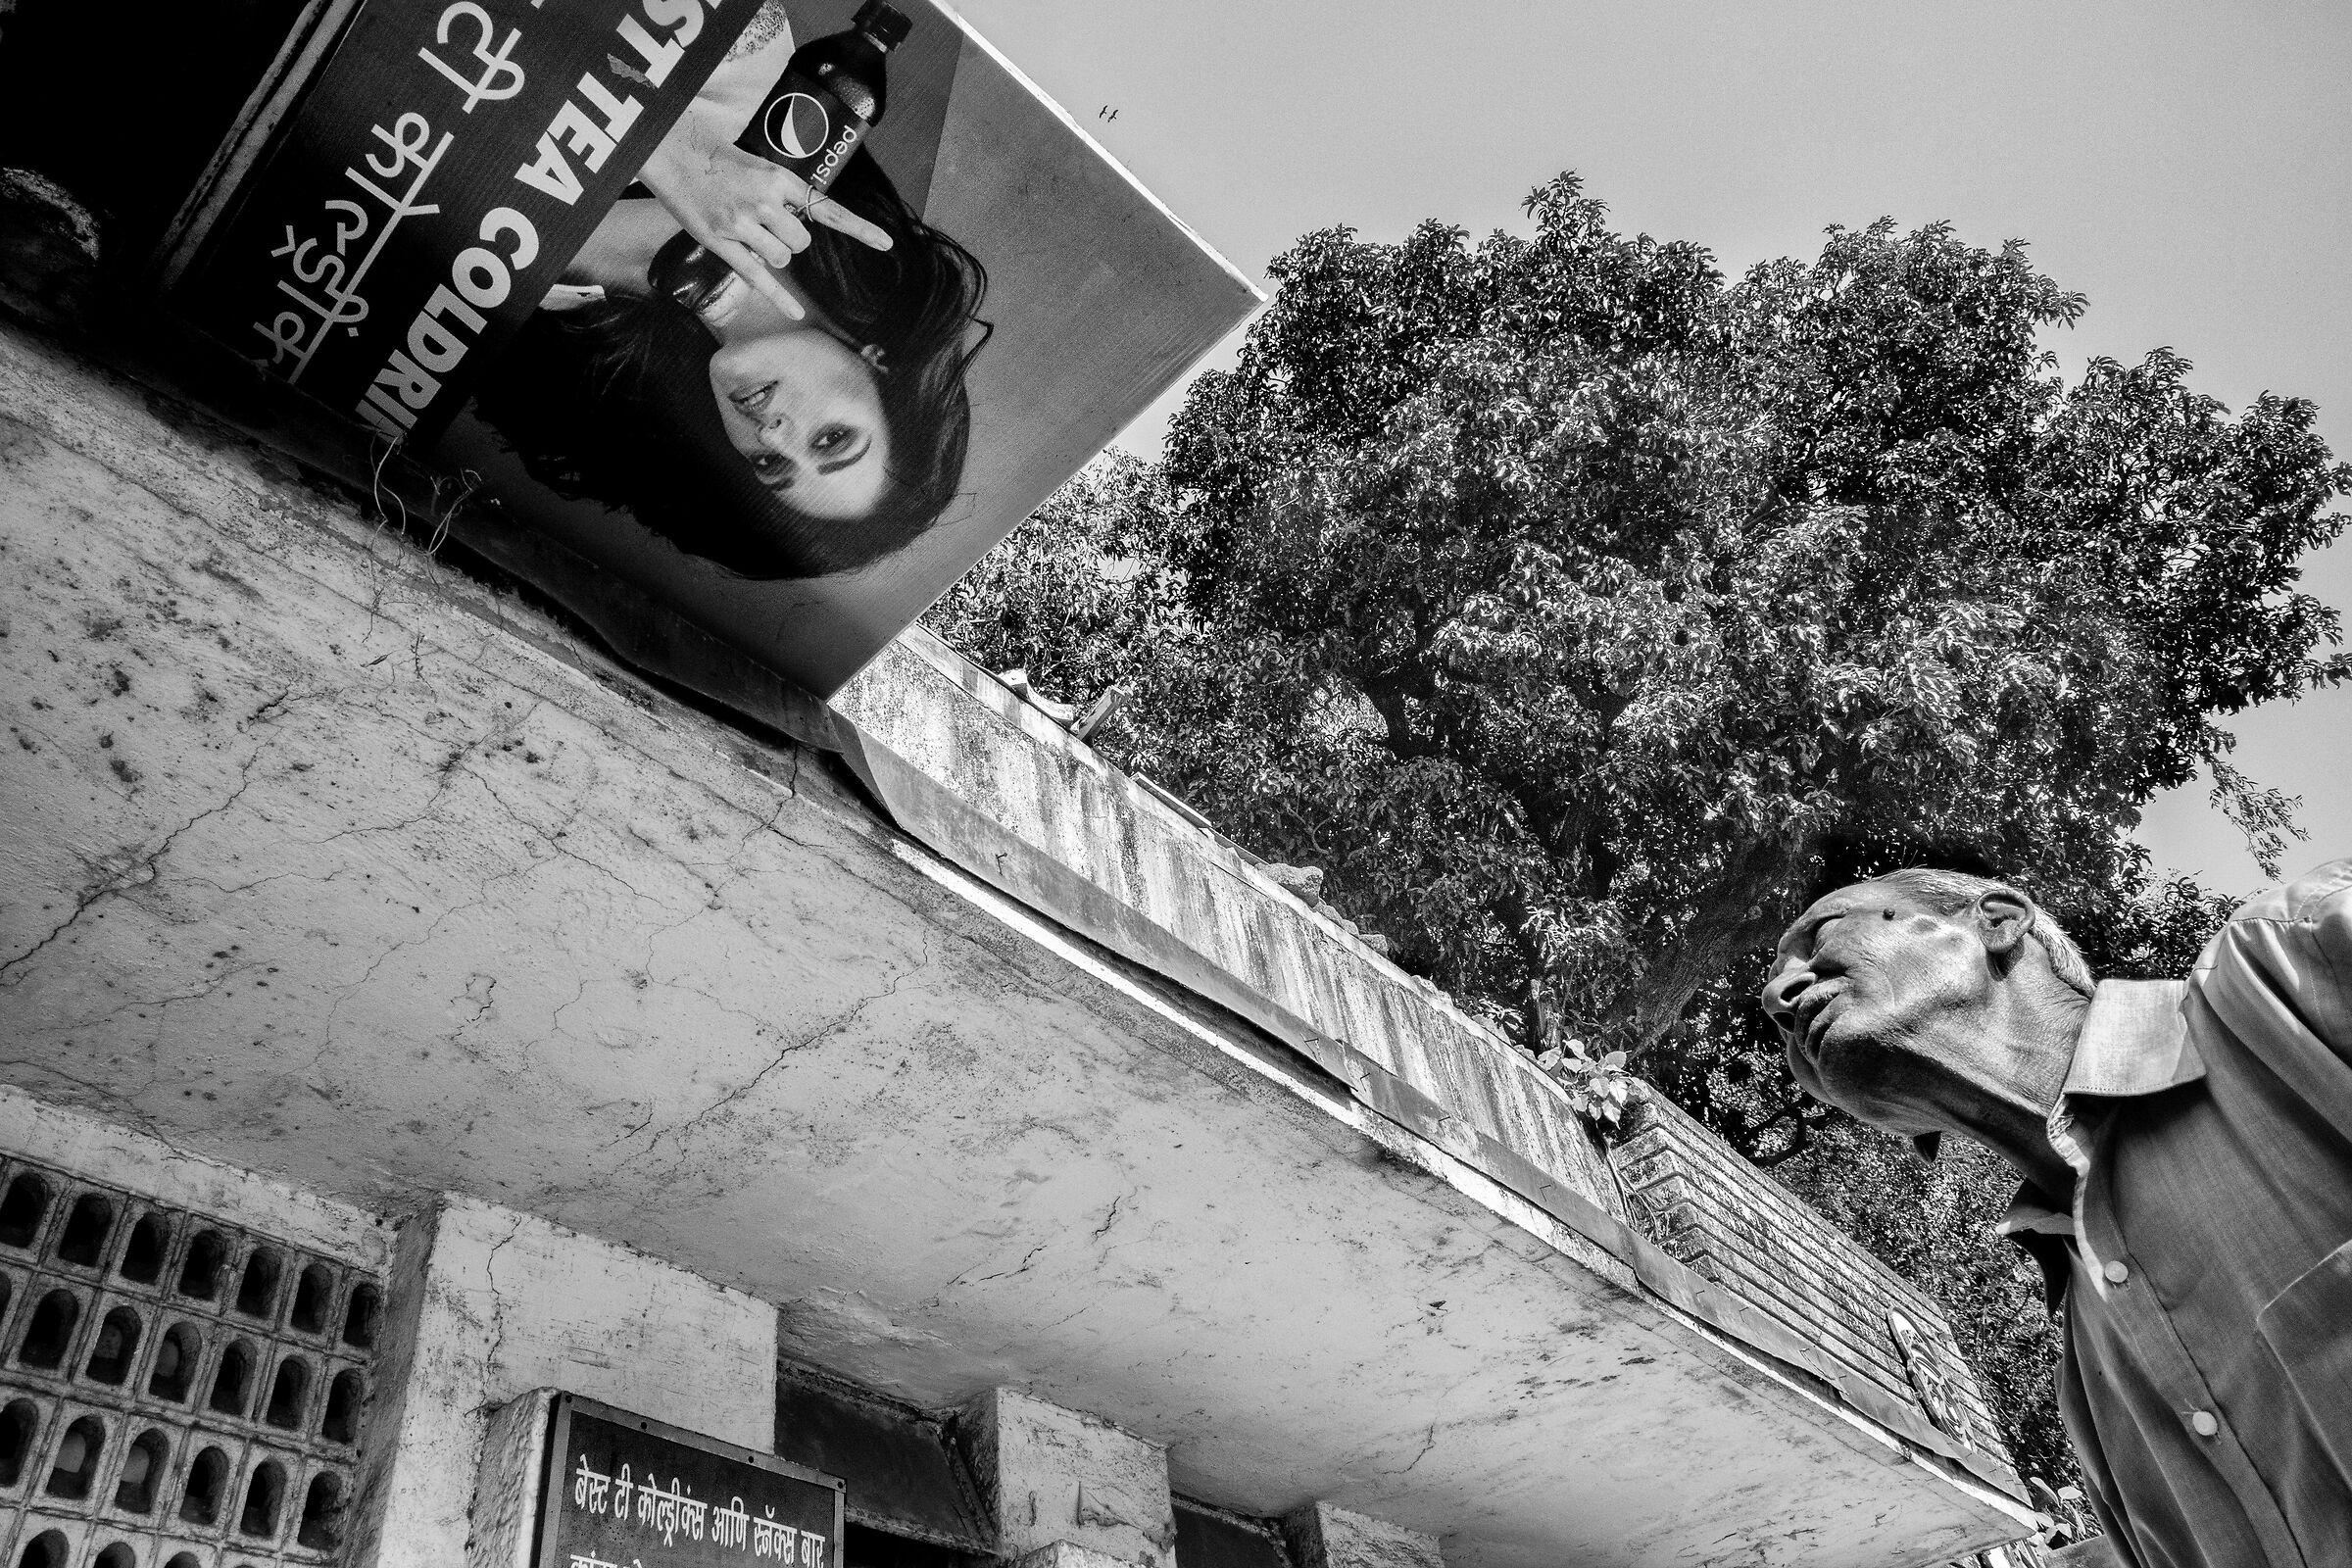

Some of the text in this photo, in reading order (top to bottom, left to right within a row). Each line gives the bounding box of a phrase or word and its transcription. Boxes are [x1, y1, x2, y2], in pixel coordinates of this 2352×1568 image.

[417, 0, 525, 115] टी
[616, 0, 722, 88] ST
[514, 72, 644, 205] TEA
[810, 124, 858, 185] pepsi
[575, 1454, 611, 1514] बेस्ट
[614, 1463, 633, 1520] टी
[711, 1495, 750, 1551] आणि
[801, 1530, 825, 1568] बार
